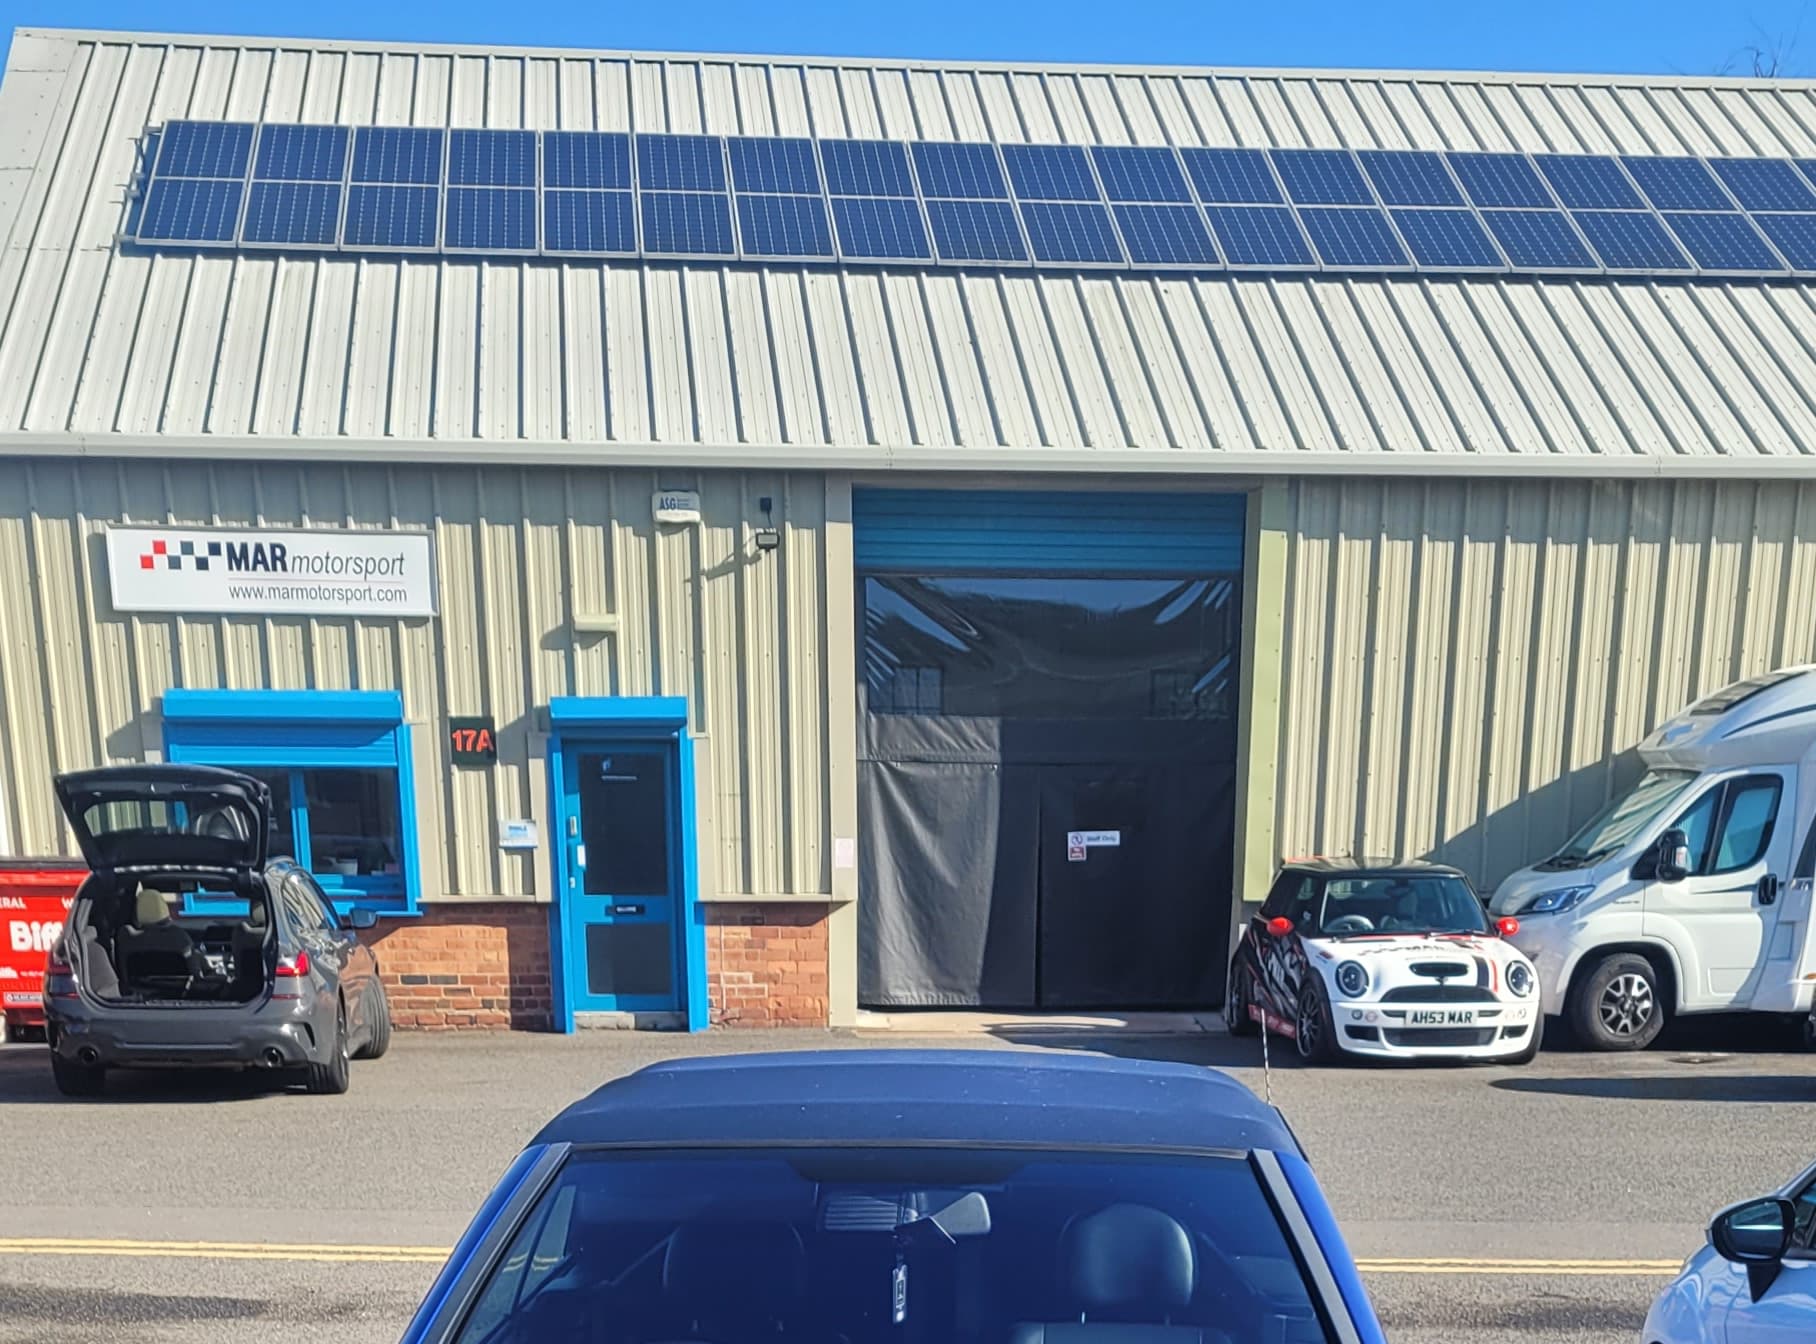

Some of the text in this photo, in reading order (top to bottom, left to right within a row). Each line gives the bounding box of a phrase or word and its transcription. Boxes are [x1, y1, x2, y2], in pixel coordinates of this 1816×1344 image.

[659, 497, 677, 510] ASG
[225, 541, 405, 582] MAR motorsport
[229, 584, 408, 605] www.marmotorsport.com
[452, 728, 494, 752] 17A
[0, 896, 27, 910] RAL
[9, 920, 64, 952] Biff
[1411, 1011, 1473, 1025] AH53 MAR
